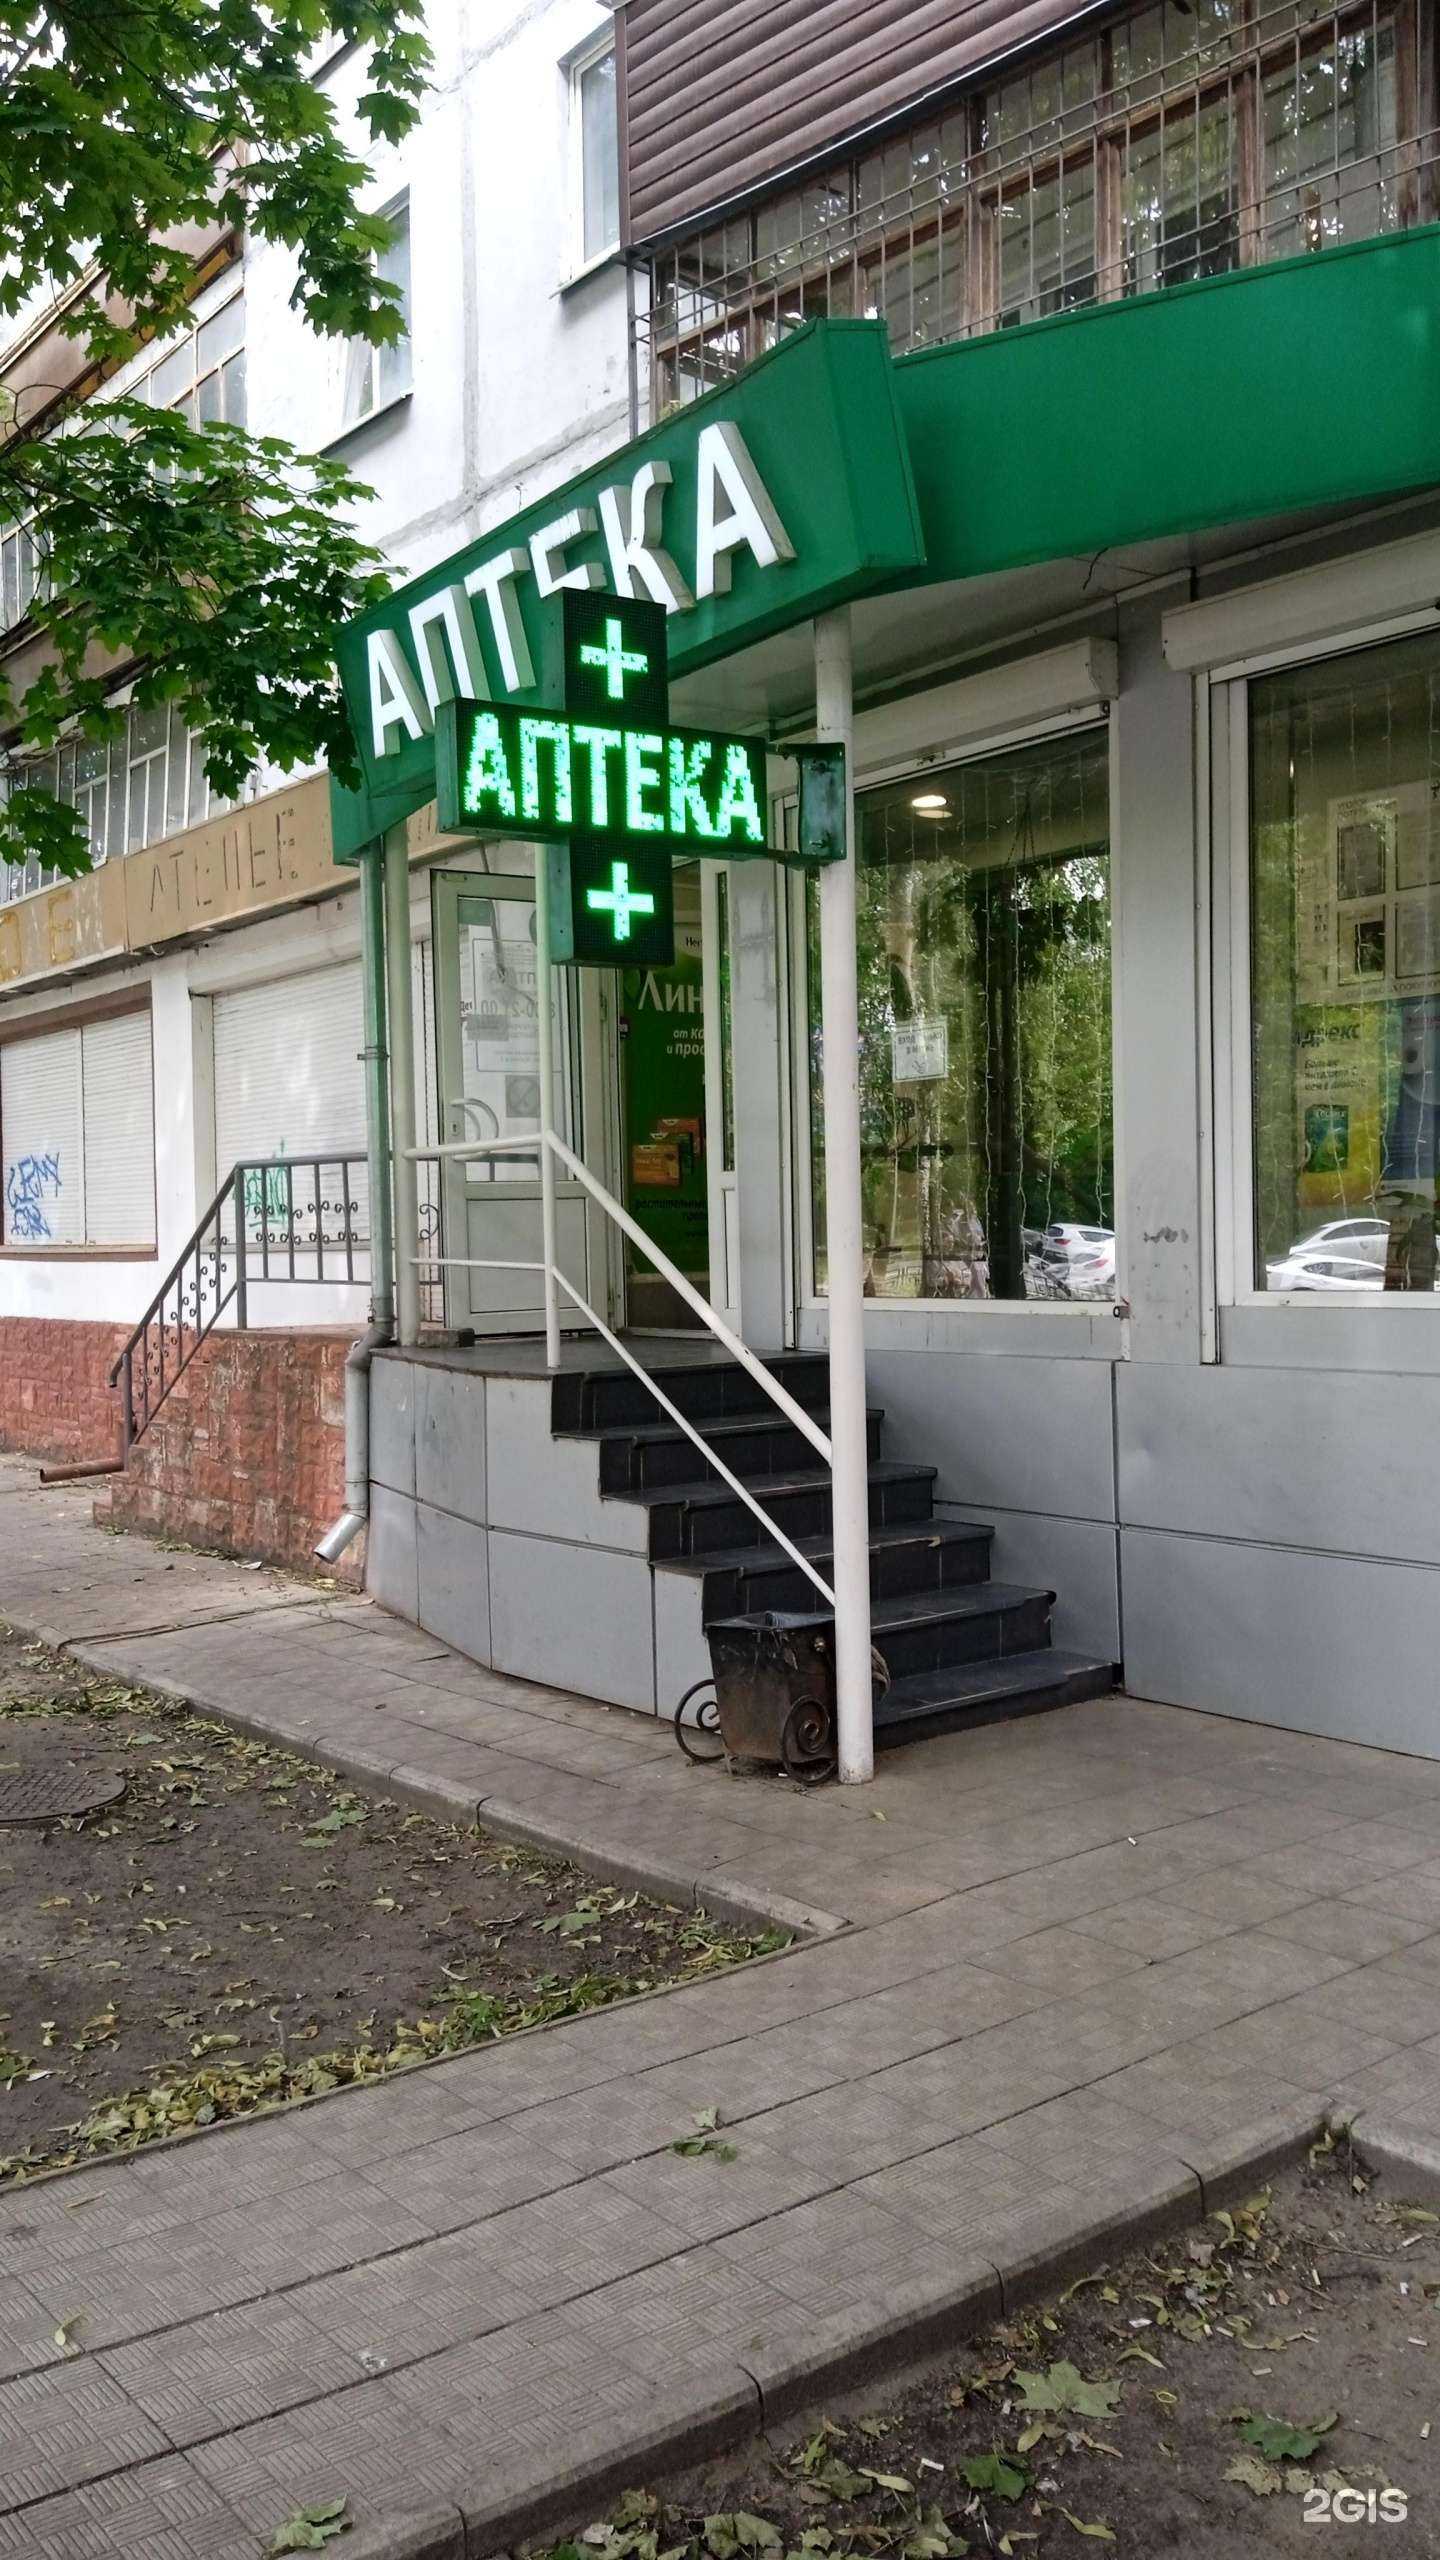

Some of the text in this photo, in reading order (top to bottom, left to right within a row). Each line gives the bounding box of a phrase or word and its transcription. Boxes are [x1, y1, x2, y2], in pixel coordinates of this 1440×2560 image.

[367, 421, 796, 759] АПТЕКА
[463, 713, 764, 842] АПТЕКА
[638, 970, 704, 1013] Лин
[673, 1030, 689, 1039] от
